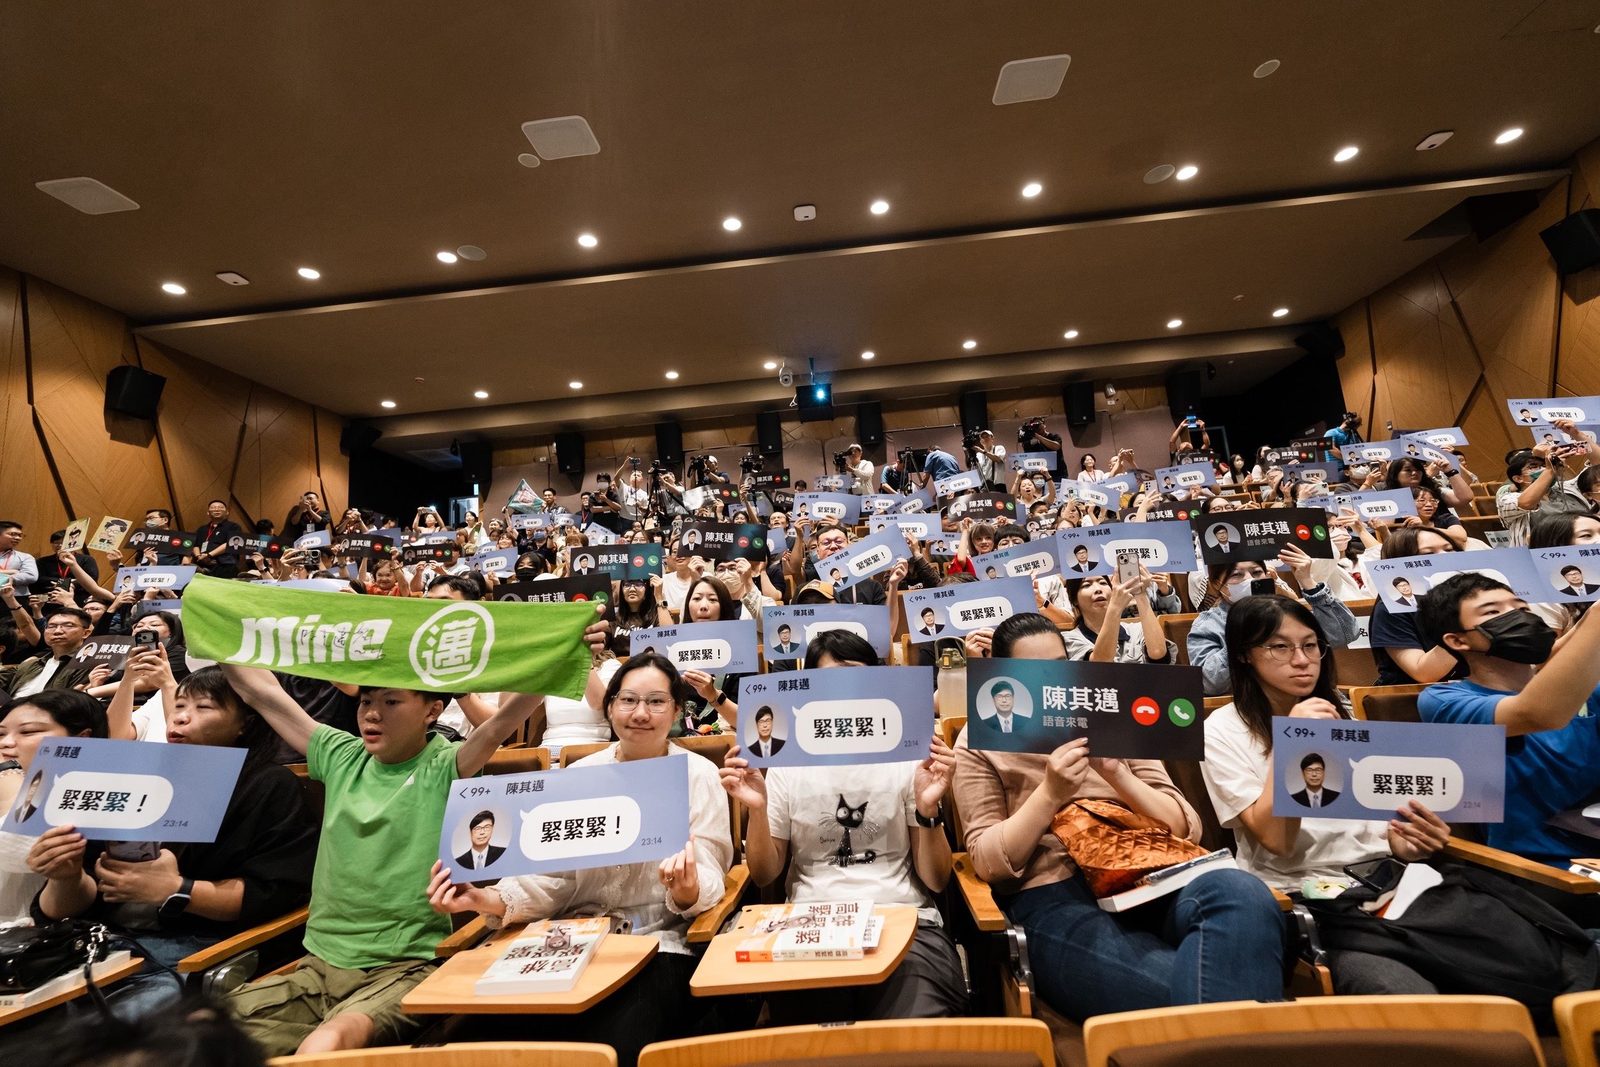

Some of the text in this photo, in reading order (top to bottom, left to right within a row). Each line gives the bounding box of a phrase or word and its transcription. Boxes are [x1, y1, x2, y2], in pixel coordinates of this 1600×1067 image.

[705, 531, 733, 543] 陳其邁
[1244, 521, 1291, 537] 陳其邁
[598, 553, 629, 564] 陳其邁
[960, 605, 1004, 622] 緊緊緊！
[227, 614, 392, 668] mine
[422, 617, 480, 675] 邁
[678, 648, 721, 663] 緊緊緊！
[752, 678, 810, 693] 99+ 陳其邁
[1042, 685, 1120, 713] 陳其邁
[813, 716, 888, 739] 緊緊緊！
[1042, 716, 1088, 729] 語音來電
[1294, 727, 1371, 743] 99+ 陳其邁
[470, 779, 544, 798] 99+ 陳其邁
[1373, 773, 1447, 796] 緊緊緊！
[58, 788, 148, 813] 緊緊緊！
[163, 819, 188, 828] 23:14
[540, 815, 621, 843] 緊緊緊！
[641, 836, 662, 846] 23:14
